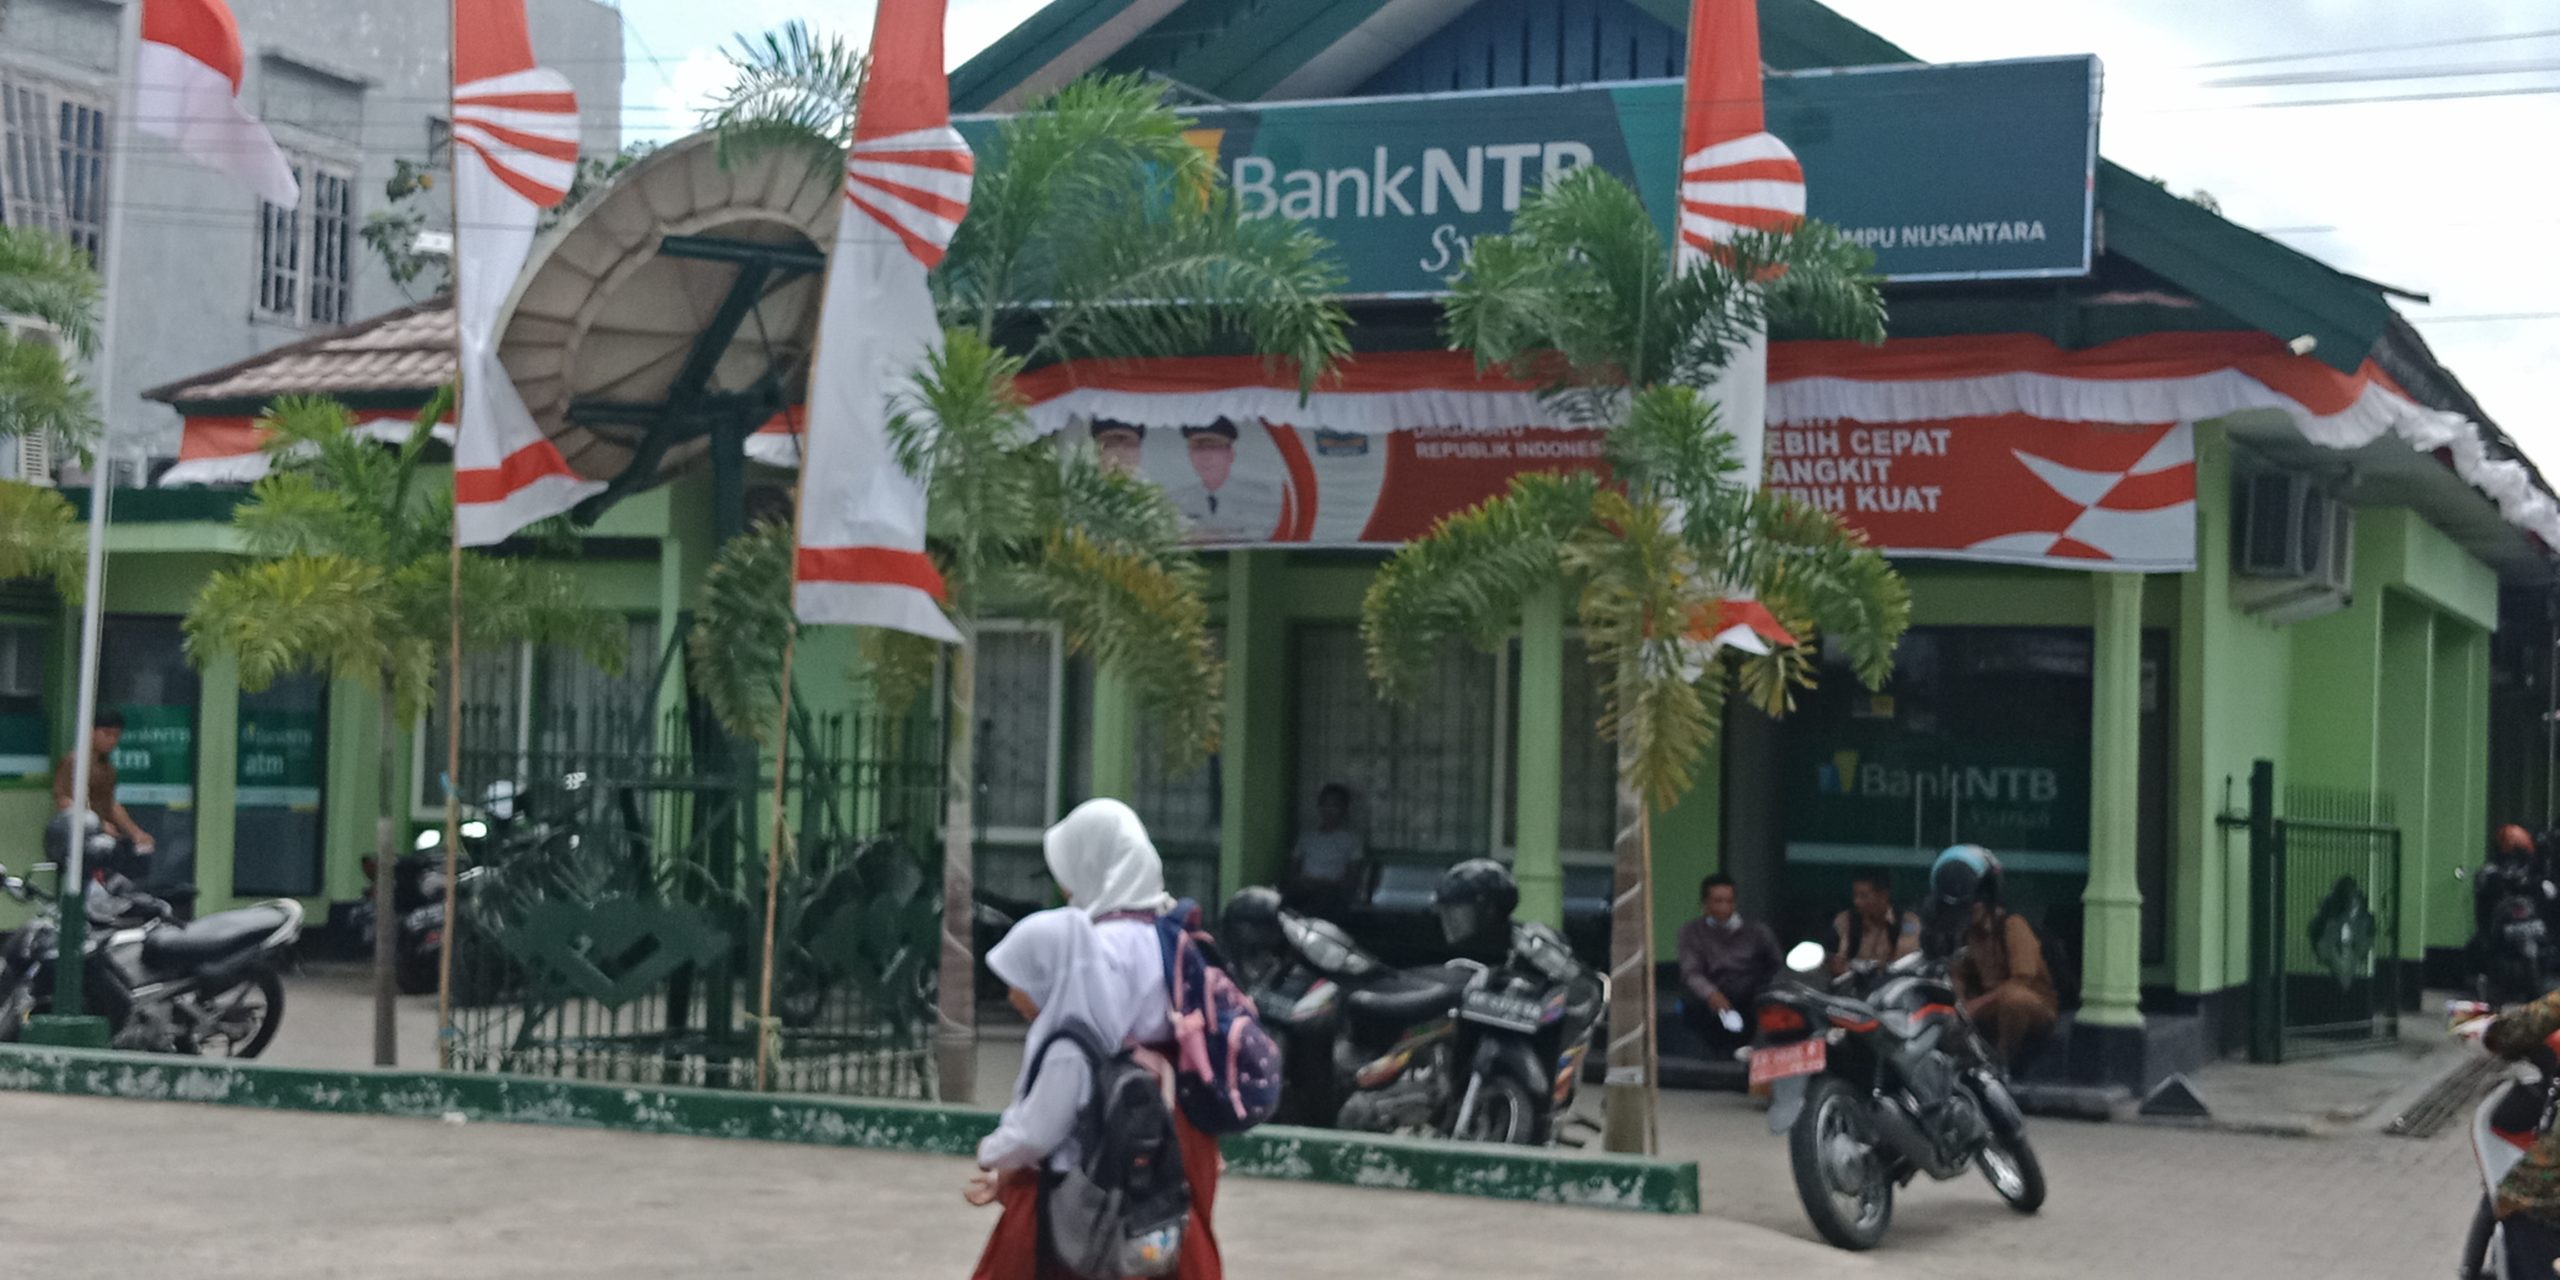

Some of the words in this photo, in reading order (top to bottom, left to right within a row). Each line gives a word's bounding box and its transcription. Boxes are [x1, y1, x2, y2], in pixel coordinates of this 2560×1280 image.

[1902, 220, 2047, 248] NUSANTARA
[1415, 441, 1513, 459] REPUBLIK
[1515, 440, 1604, 458] INDONES
[1766, 429, 1841, 456] EBIH
[1851, 428, 1951, 456] CEPAT
[1772, 457, 1892, 484] ANGKIT
[1854, 485, 1942, 513] KUAT
[111, 746, 150, 769] tm
[244, 752, 285, 776] atm
